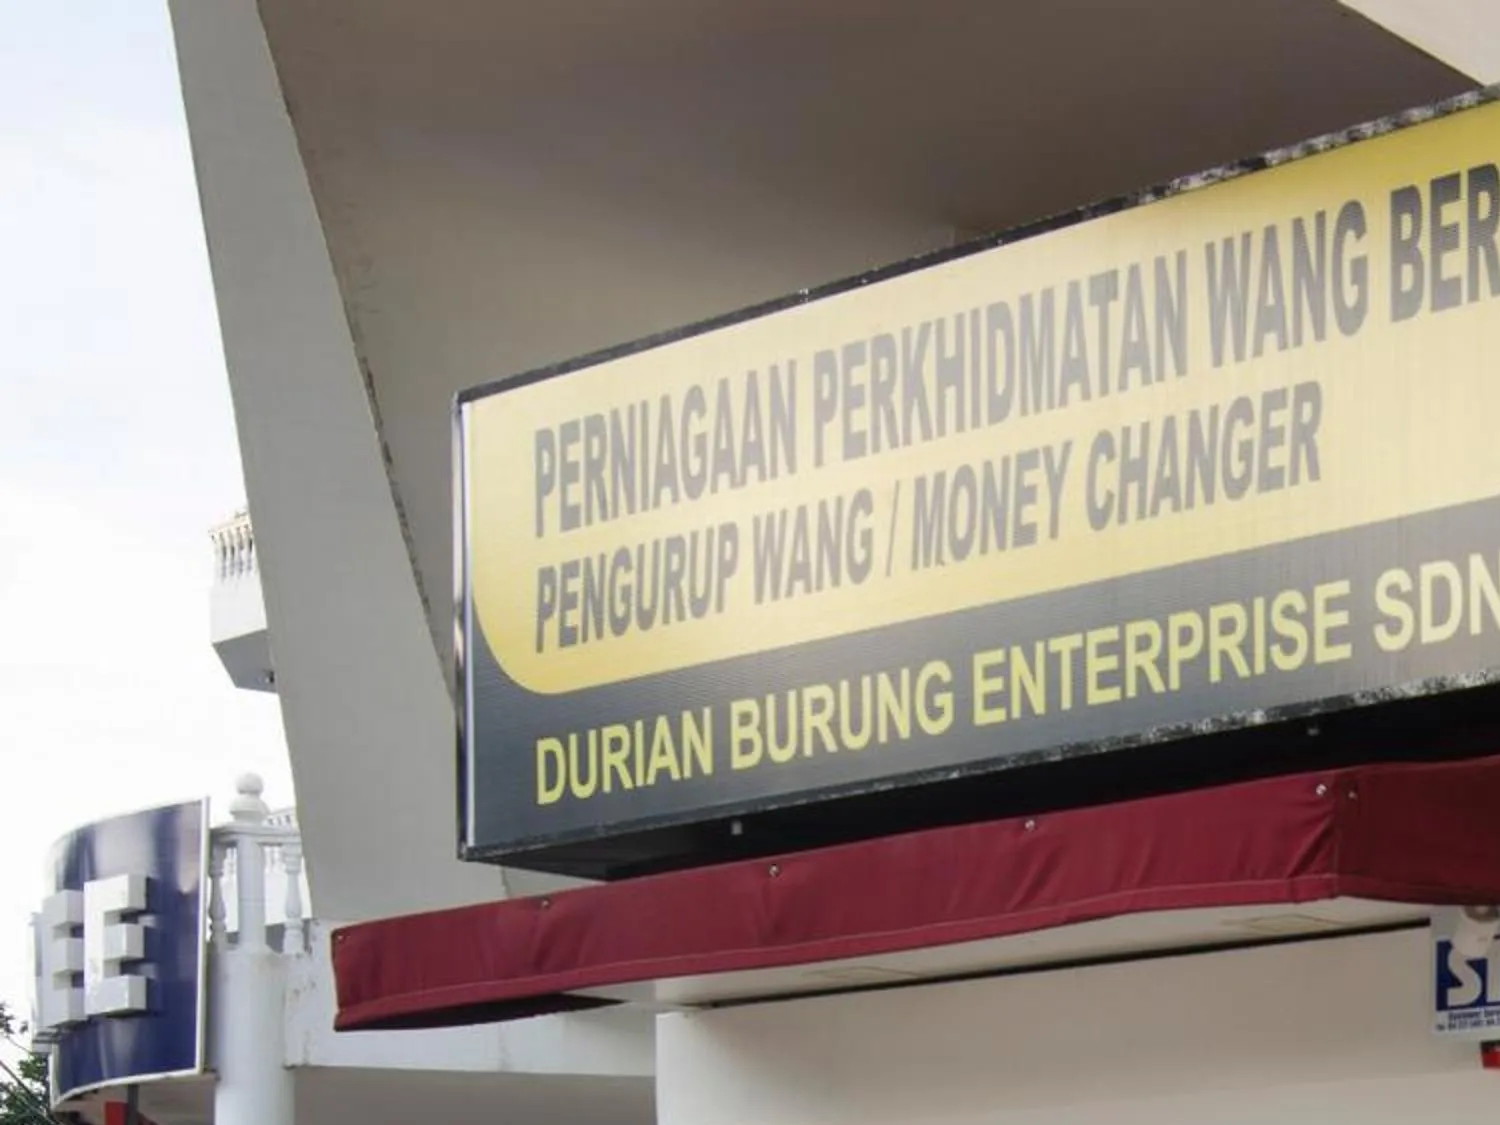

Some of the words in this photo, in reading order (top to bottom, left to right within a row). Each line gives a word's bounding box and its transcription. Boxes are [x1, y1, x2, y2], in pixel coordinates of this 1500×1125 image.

[534, 358, 798, 538] PERNIAGAAN
[812, 250, 1188, 468] PERKHIDMATAN
[1205, 199, 1369, 369] WANG
[535, 520, 740, 654] PENGURUP
[752, 486, 873, 605] WANG
[911, 439, 1074, 571] MONEY
[1086, 380, 1323, 533] CHANGER
[536, 707, 713, 805] DURIAN
[731, 660, 955, 771] BURUNG
[972, 580, 1352, 727] ENTERPRISE
